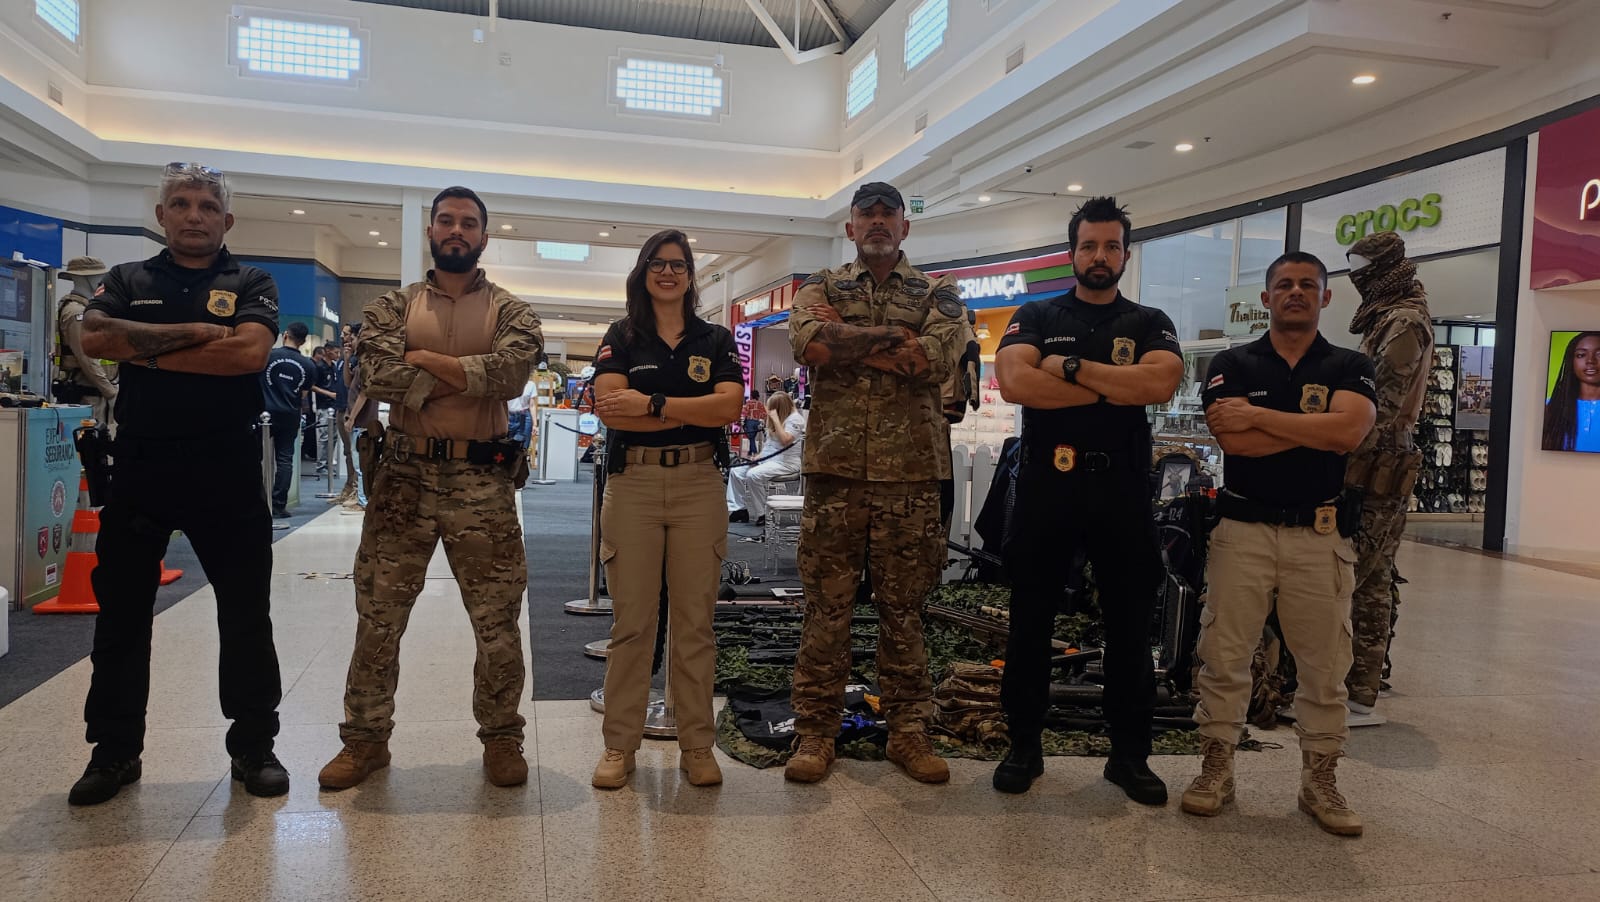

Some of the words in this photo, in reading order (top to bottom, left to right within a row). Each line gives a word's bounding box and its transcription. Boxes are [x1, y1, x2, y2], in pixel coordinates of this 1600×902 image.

[1336, 193, 1441, 246] crocs
[957, 273, 1027, 300] CRIANÇA
[1230, 302, 1269, 323] Thalita
[1044, 336, 1076, 345] DELEGADO
[736, 331, 751, 386] SPORT
